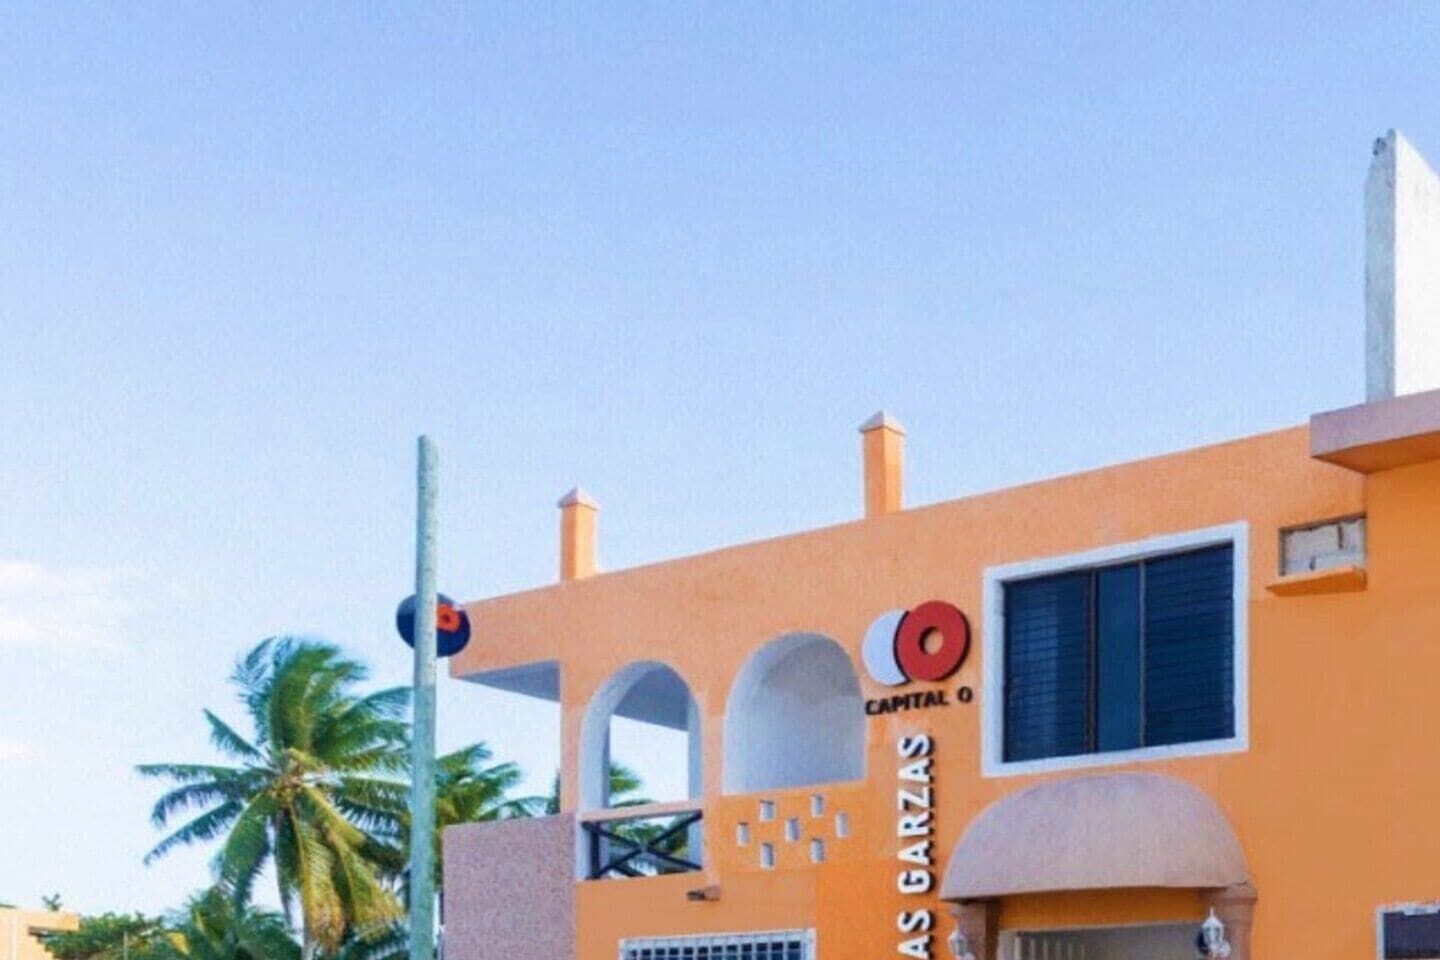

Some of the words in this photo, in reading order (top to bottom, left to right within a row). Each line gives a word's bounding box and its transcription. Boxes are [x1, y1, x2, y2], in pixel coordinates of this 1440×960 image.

[864, 689, 949, 716] CAPITAL
[957, 685, 973, 704] O
[898, 733, 933, 894] GARZAS
